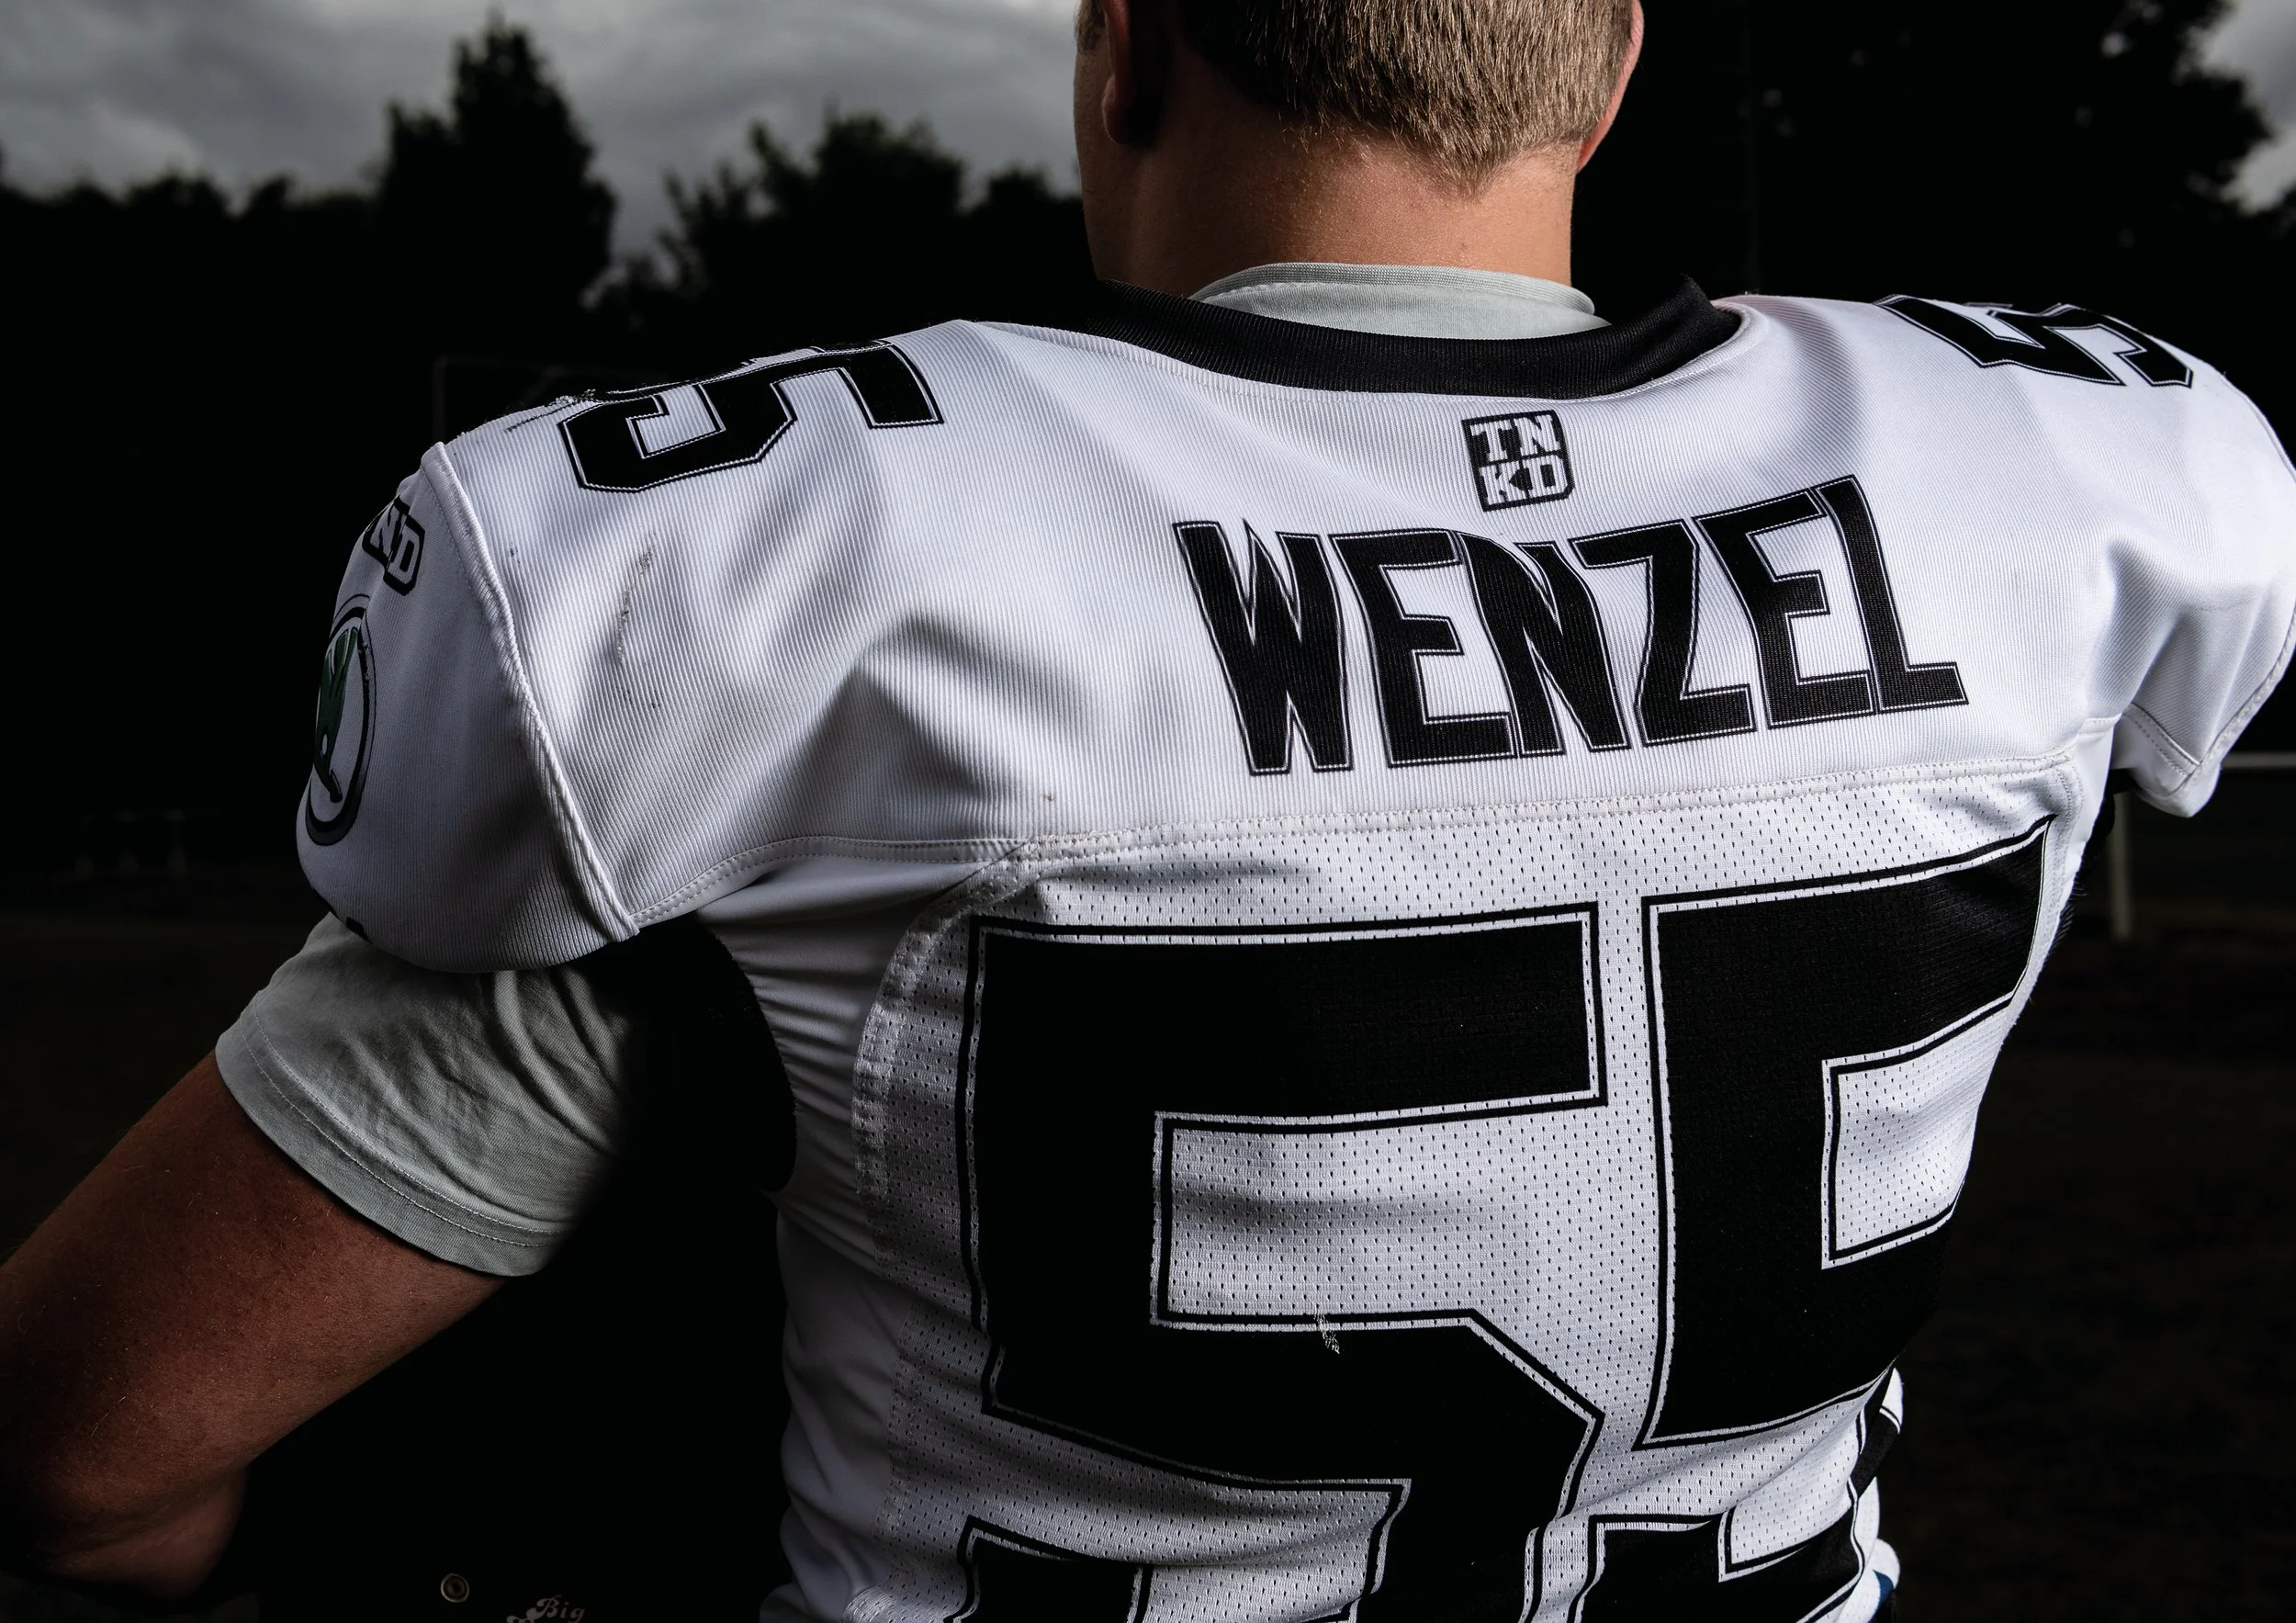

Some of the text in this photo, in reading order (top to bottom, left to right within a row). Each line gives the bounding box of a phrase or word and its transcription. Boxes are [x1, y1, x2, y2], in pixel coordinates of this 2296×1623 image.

[1469, 414, 1561, 463] TN
[1478, 455, 1569, 505] KD
[1173, 474, 1968, 775] WENZEL
[946, 816, 2052, 1623] 55
